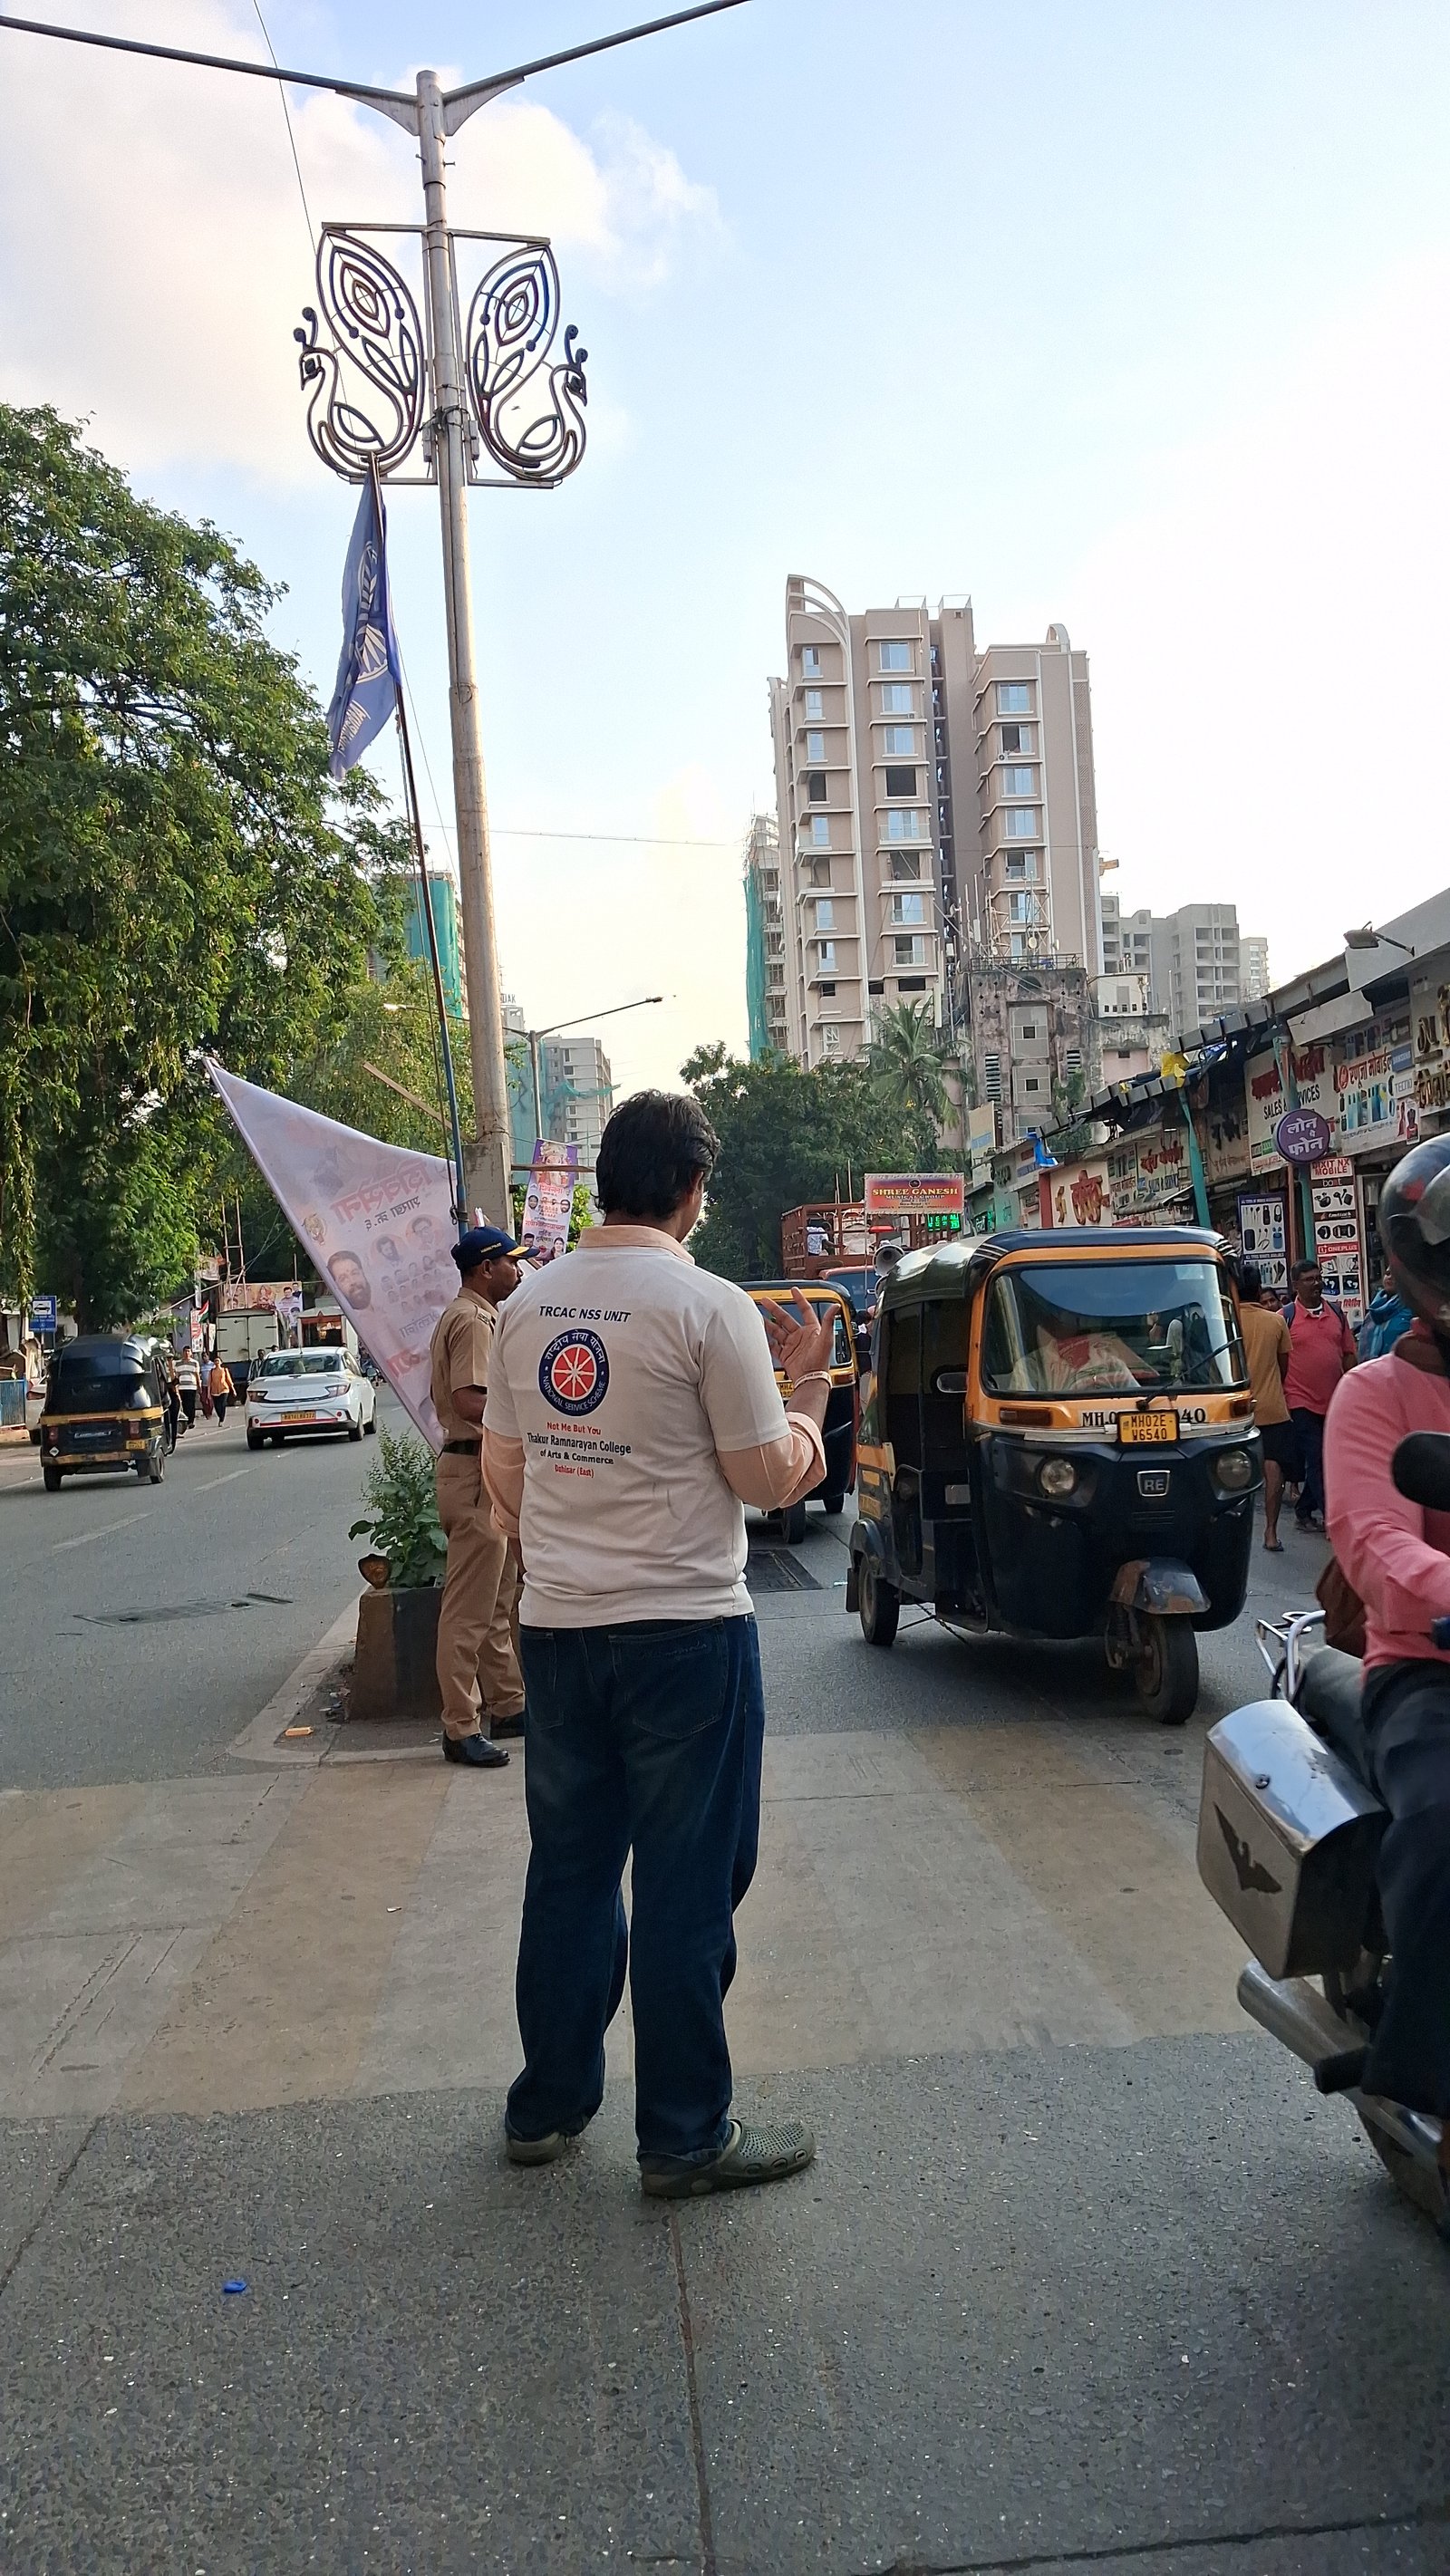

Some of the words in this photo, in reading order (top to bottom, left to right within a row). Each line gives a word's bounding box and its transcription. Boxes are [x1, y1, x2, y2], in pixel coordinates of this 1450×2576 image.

[1263, 1099, 1282, 1120] SALES
[1298, 1084, 1320, 1105] VICES
[1286, 1117, 1318, 1134] लोन
[1288, 1136, 1324, 1156] फोन
[1312, 1160, 1335, 1169] DIXIT
[1338, 1158, 1350, 1167] NX
[1315, 1166, 1348, 1176] MOBILE
[872, 1188, 910, 1196] SHREE
[1328, 1244, 1358, 1253] ONEPLUS
[538, 1306, 577, 1319] TRCAC
[579, 1308, 602, 1320] NSS
[604, 1310, 632, 1323] UNIT
[544, 1335, 569, 1360] राष्ट्रीय
[571, 1329, 590, 1342] सेवा
[590, 1336, 606, 1364] योजना
[543, 1375, 565, 1407] NATIONAL
[565, 1401, 589, 1411] SERVICE
[587, 1381, 606, 1407] SCHEME
[1082, 1411, 1116, 1427] MH.0
[1131, 1414, 1167, 1428] MH02E
[546, 1422, 560, 1432] Not
[561, 1423, 572, 1433] Me
[573, 1424, 585, 1433] But
[586, 1425, 602, 1435] You
[1132, 1428, 1167, 1441] W6540
[527, 1433, 549, 1445] Thakur
[550, 1434, 598, 1452] Ramnarayan
[599, 1441, 632, 1456] College
[540, 1449, 546, 1457] of
[546, 1450, 562, 1460] Arts
[564, 1452, 570, 1461] &
[572, 1452, 614, 1465] Commerce
[1143, 1478, 1165, 1492] RE
